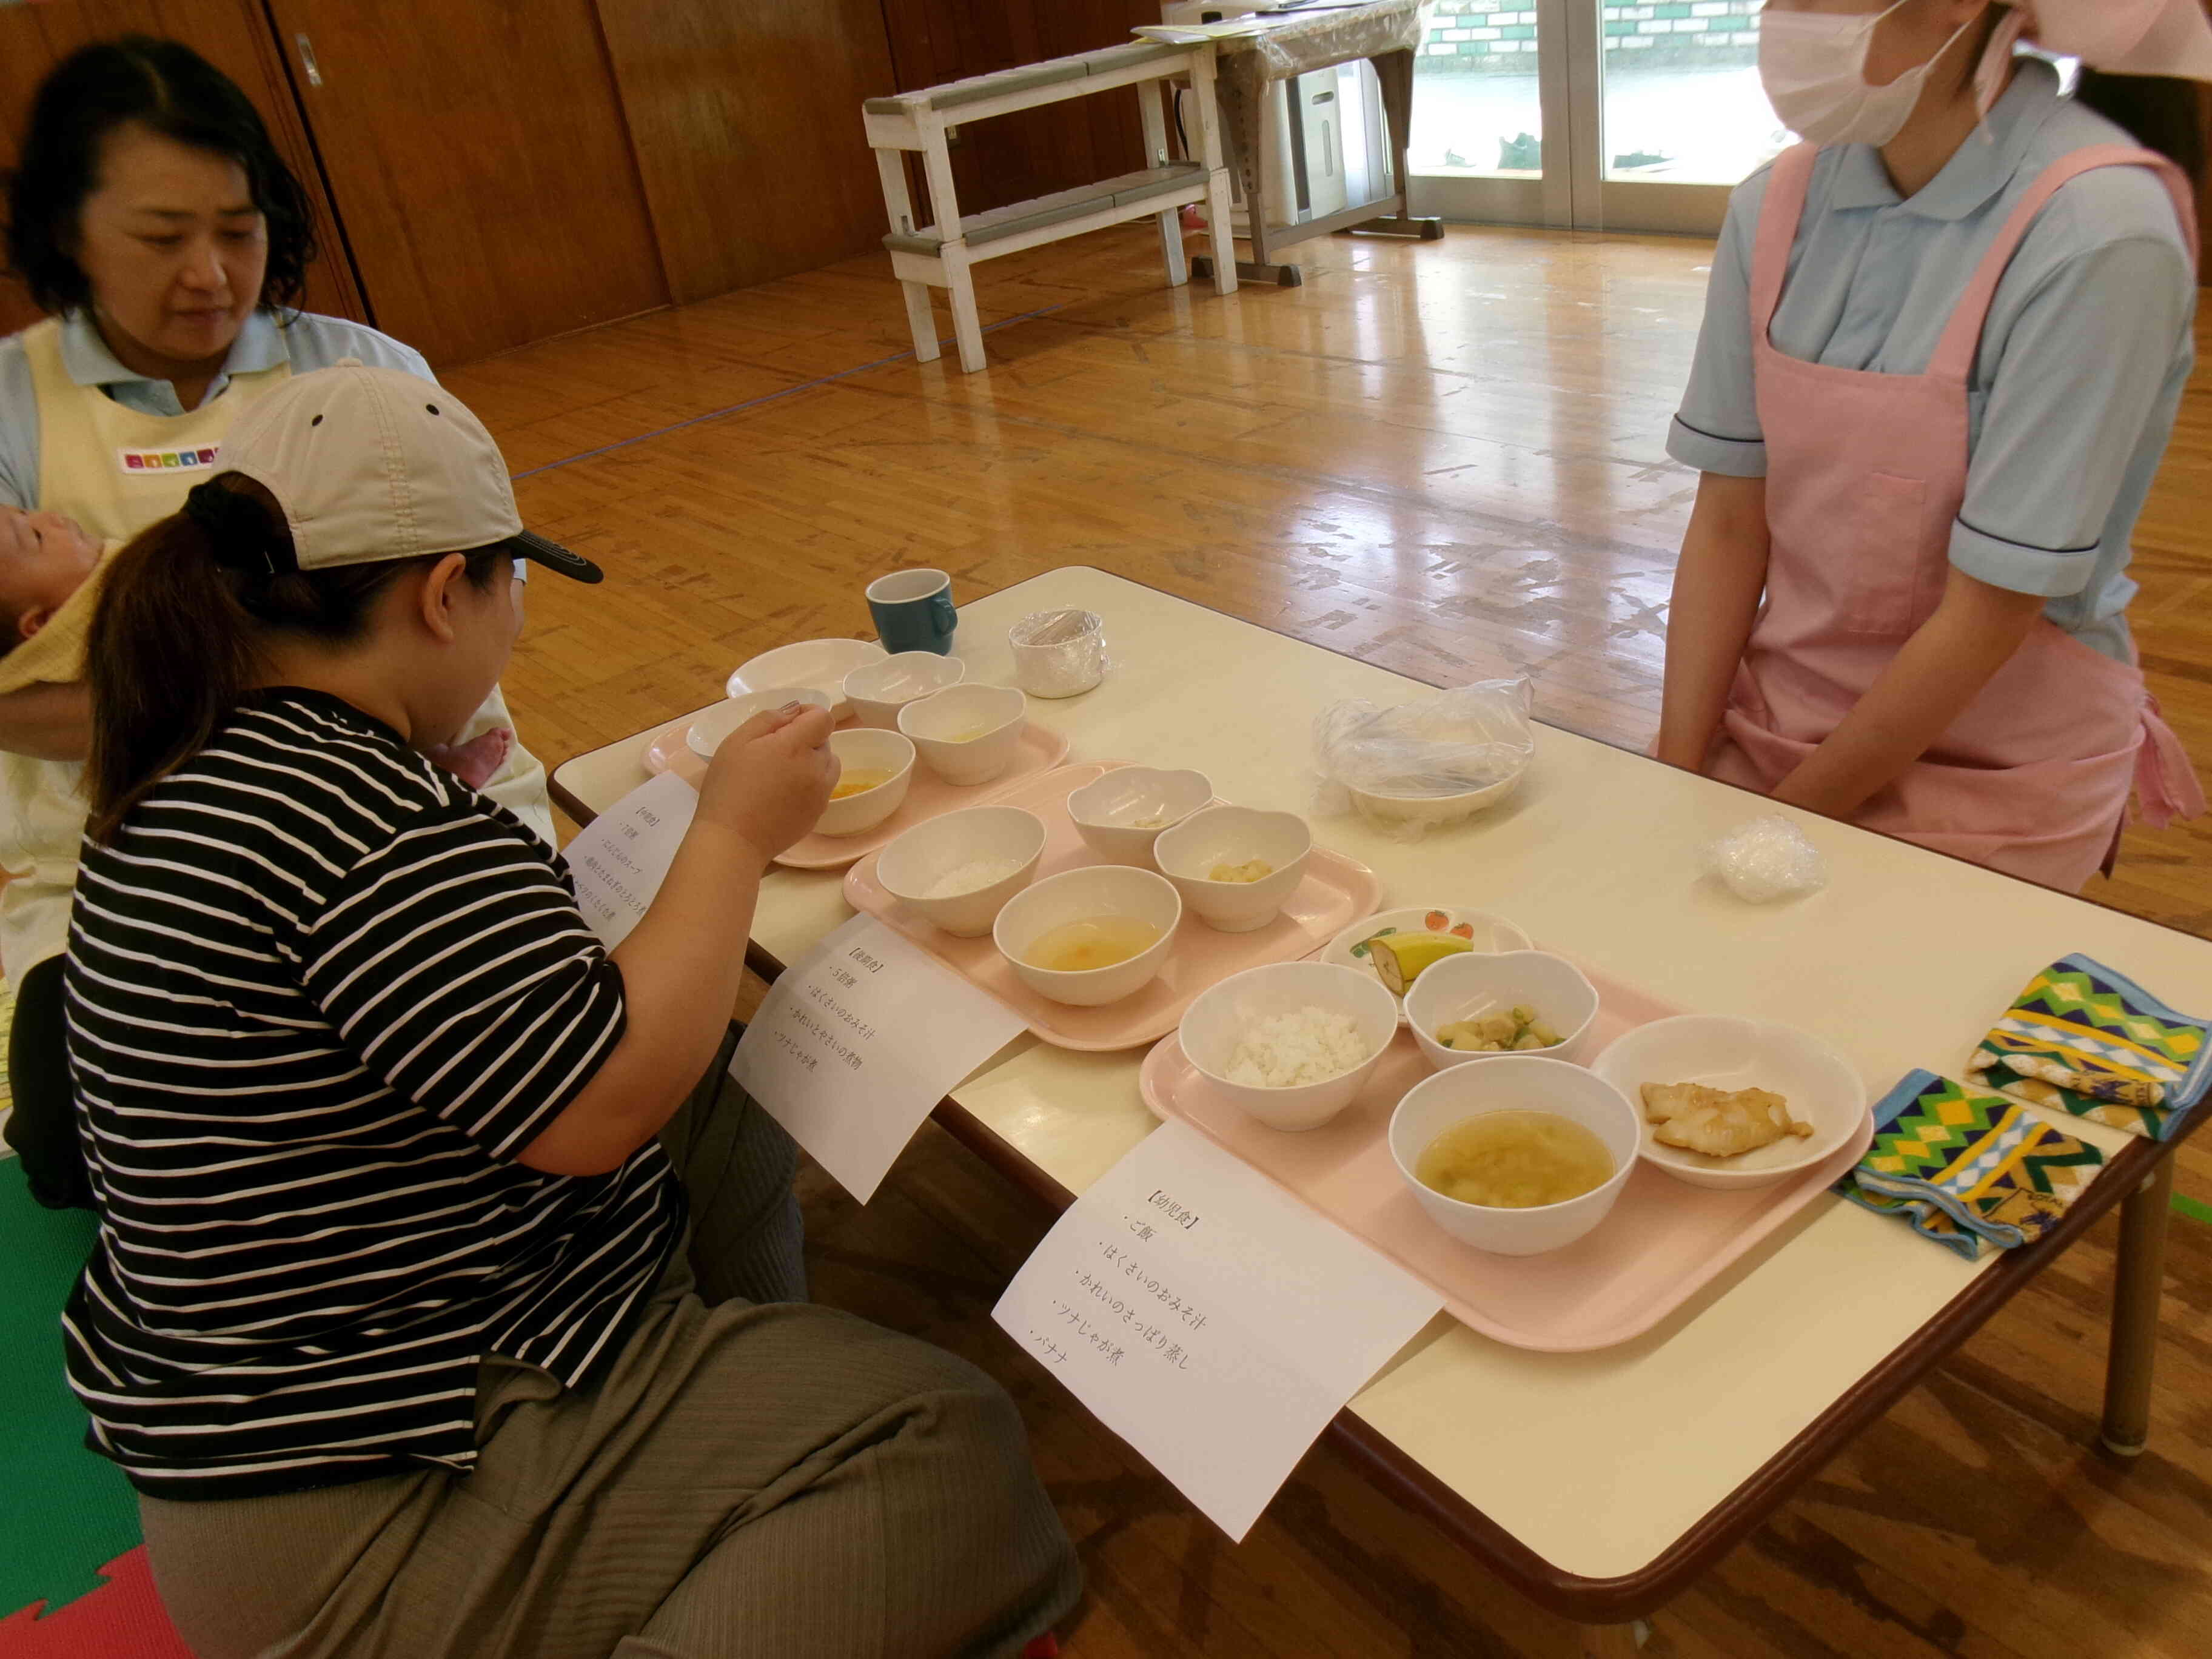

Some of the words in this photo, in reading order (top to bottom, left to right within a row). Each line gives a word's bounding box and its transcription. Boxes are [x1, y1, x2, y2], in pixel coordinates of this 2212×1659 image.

[849, 947, 883, 973] 【後期食】
[1147, 1190, 1199, 1230] 【幼児食】
